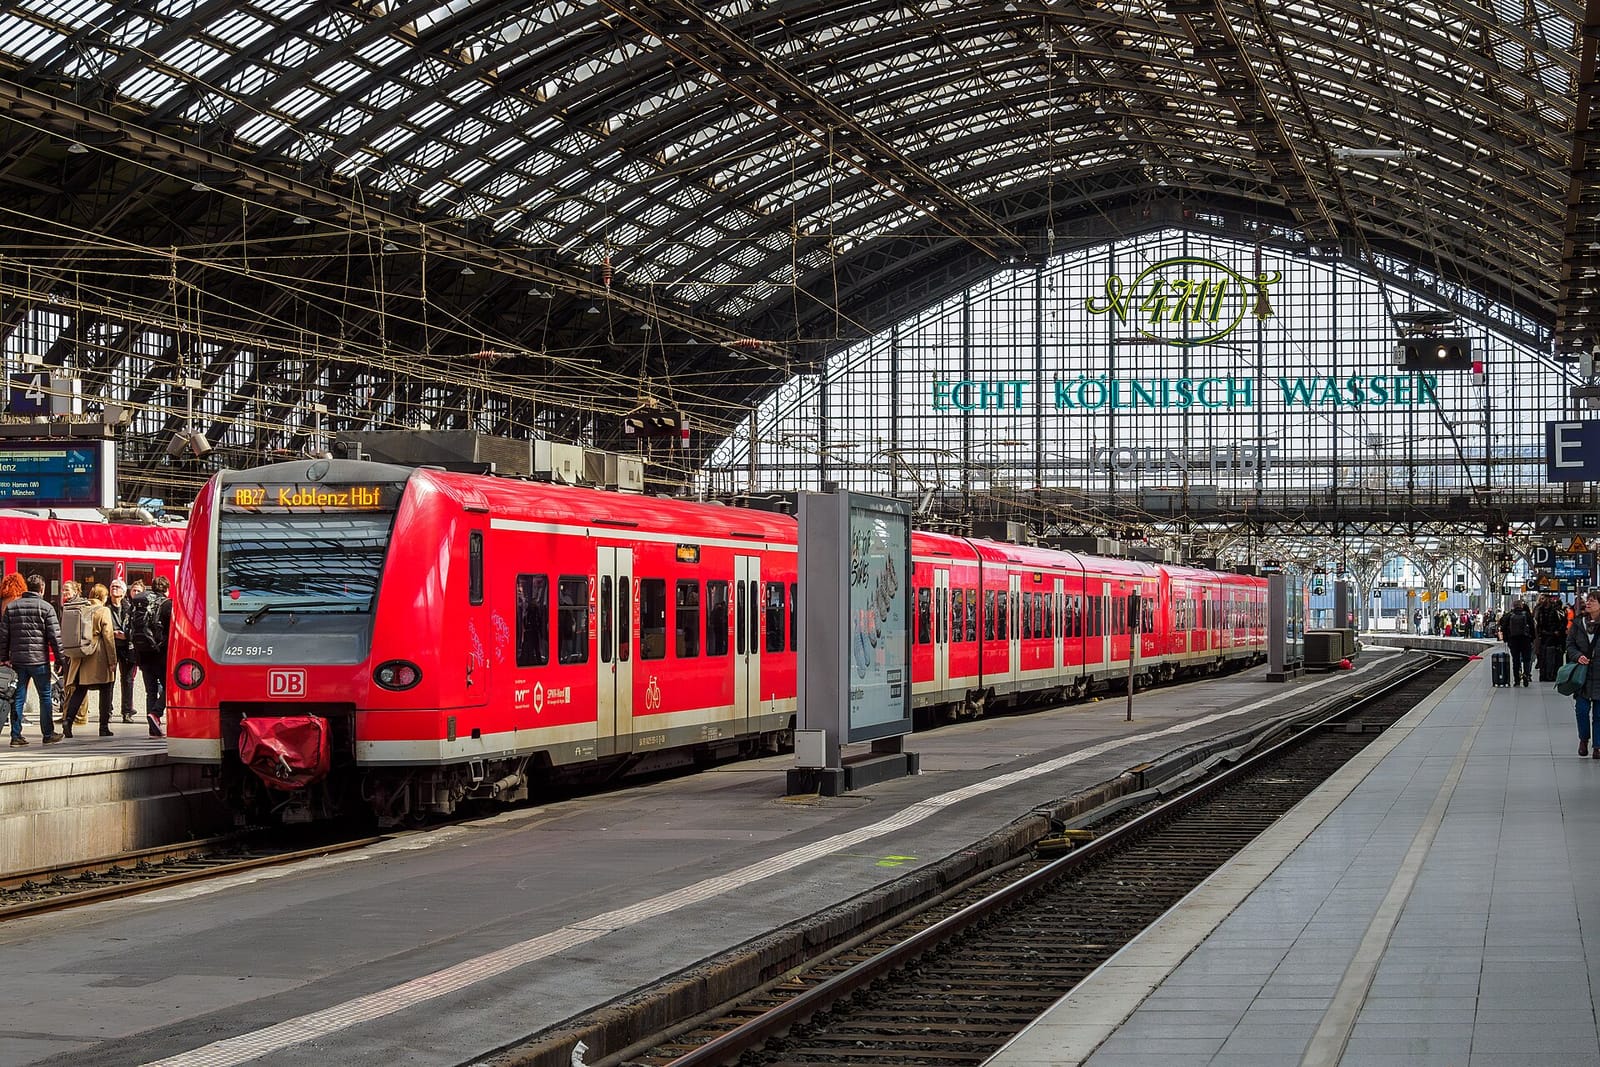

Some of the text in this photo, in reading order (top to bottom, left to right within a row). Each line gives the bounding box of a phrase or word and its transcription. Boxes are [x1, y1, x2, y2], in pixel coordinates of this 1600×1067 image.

[1139, 278, 1228, 323] 4711
[25, 374, 45, 406] 4
[932, 374, 1438, 410] ECHT KÖLNISCH WASSER
[1555, 422, 1584, 468] E
[1210, 444, 1279, 472] HBF
[235, 487, 381, 506] RB27 Koblenz Hbf
[1536, 547, 1549, 564] D
[117, 562, 123, 580] 2
[590, 577, 595, 602] 2
[634, 579, 639, 602] 2
[728, 582, 734, 603] 2
[761, 583, 766, 603] 2
[1527, 579, 1535, 589] C
[225, 646, 273, 656] 425 591-5
[271, 672, 303, 694] DB
